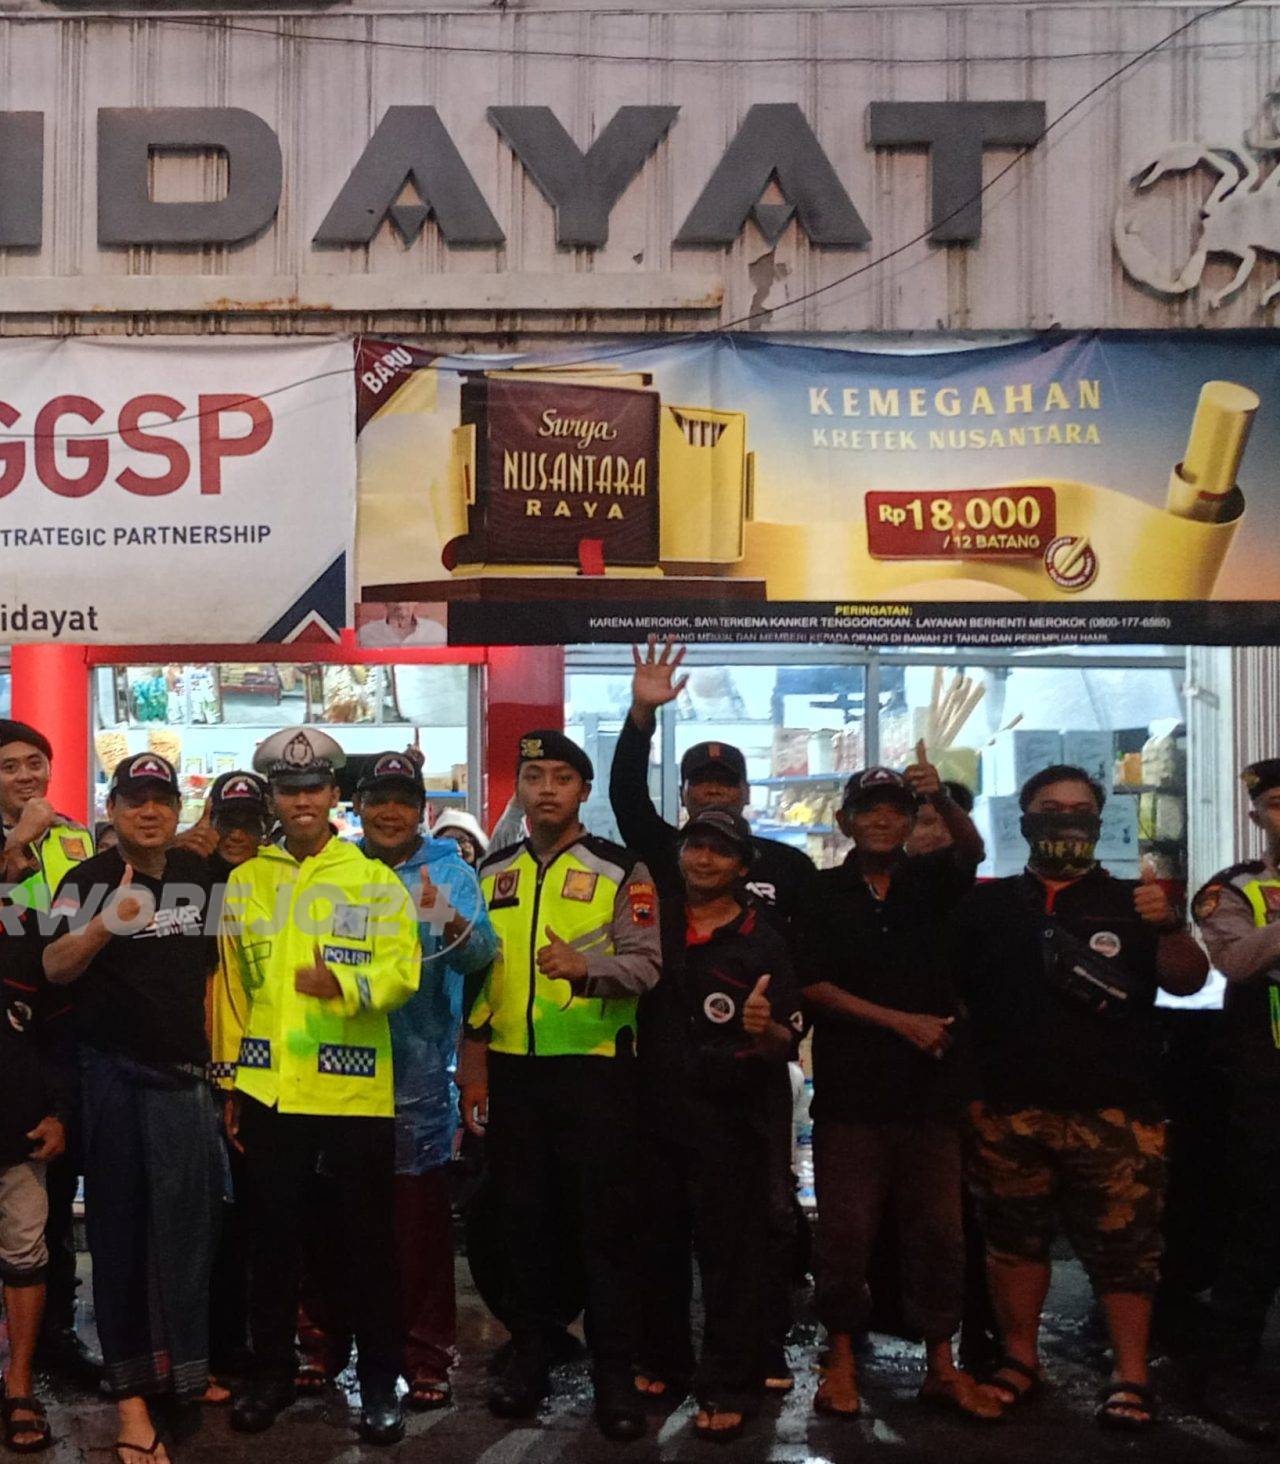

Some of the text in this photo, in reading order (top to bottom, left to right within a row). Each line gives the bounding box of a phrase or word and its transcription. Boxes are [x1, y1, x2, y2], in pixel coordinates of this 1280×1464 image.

[361, 346, 413, 395] BARU
[808, 379, 1103, 417] KEMEGAHAN
[539, 408, 618, 450] Surya
[812, 423, 1102, 452] KRETEK NUSANTARA
[504, 449, 646, 497] NUSANTARA
[526, 498, 625, 520] RAYA
[114, 525, 272, 547] PARTNERSHIP
[954, 535, 972, 549] 12
[976, 534, 1041, 549] BATANG
[590, 616, 634, 628] KARENA
[720, 616, 768, 628] TERKENA
[770, 616, 818, 628] KANKER
[916, 616, 967, 628] LAYANAN
[969, 616, 1026, 628] BERHENTI
[1028, 616, 1086, 628] MEROKOK
[835, 606, 913, 617] PERINGATAN:
[903, 633, 940, 643] BAWAH
[955, 633, 989, 643] TAHUN
[991, 633, 1012, 643] DAN
[324, 946, 371, 964] POLISI
